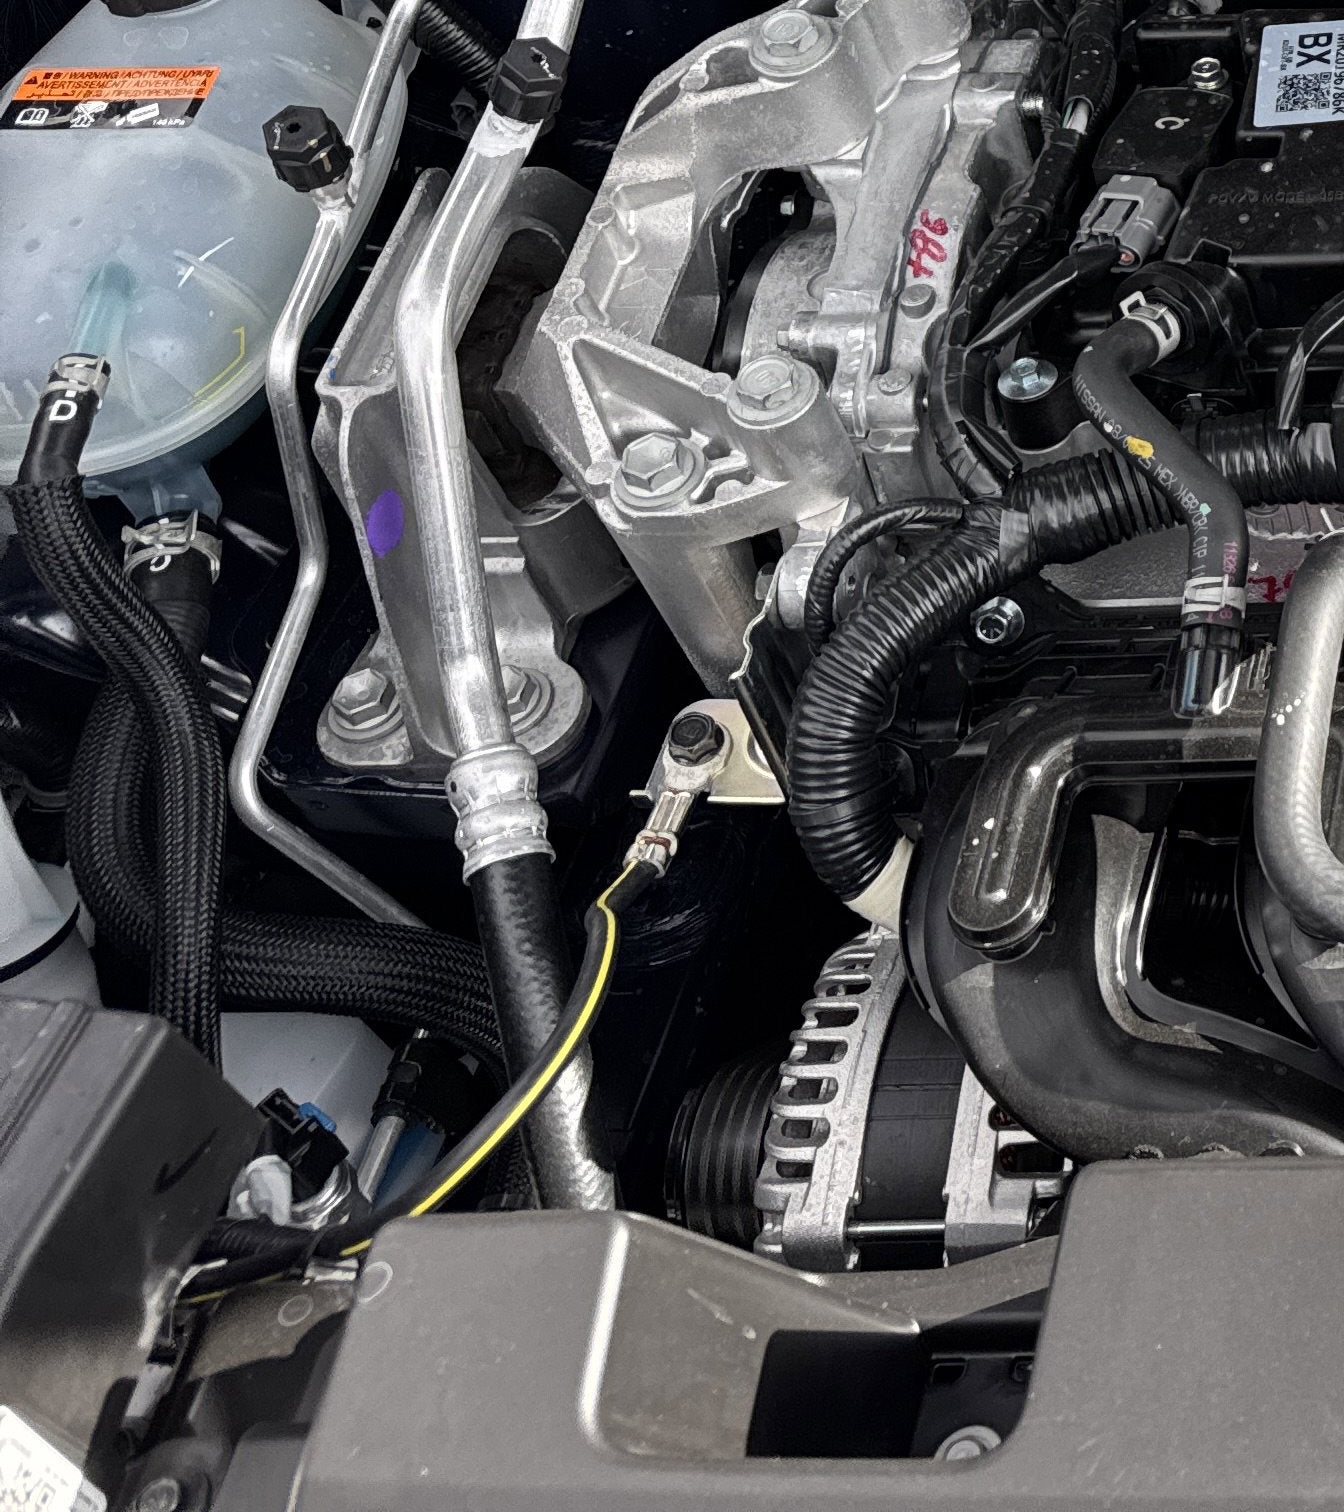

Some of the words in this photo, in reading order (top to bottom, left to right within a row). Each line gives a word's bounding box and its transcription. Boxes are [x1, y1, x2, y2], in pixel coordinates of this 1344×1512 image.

[1296, 33, 1334, 69] BX
[49, 401, 77, 421] D
[1153, 463, 1179, 490] MEX
